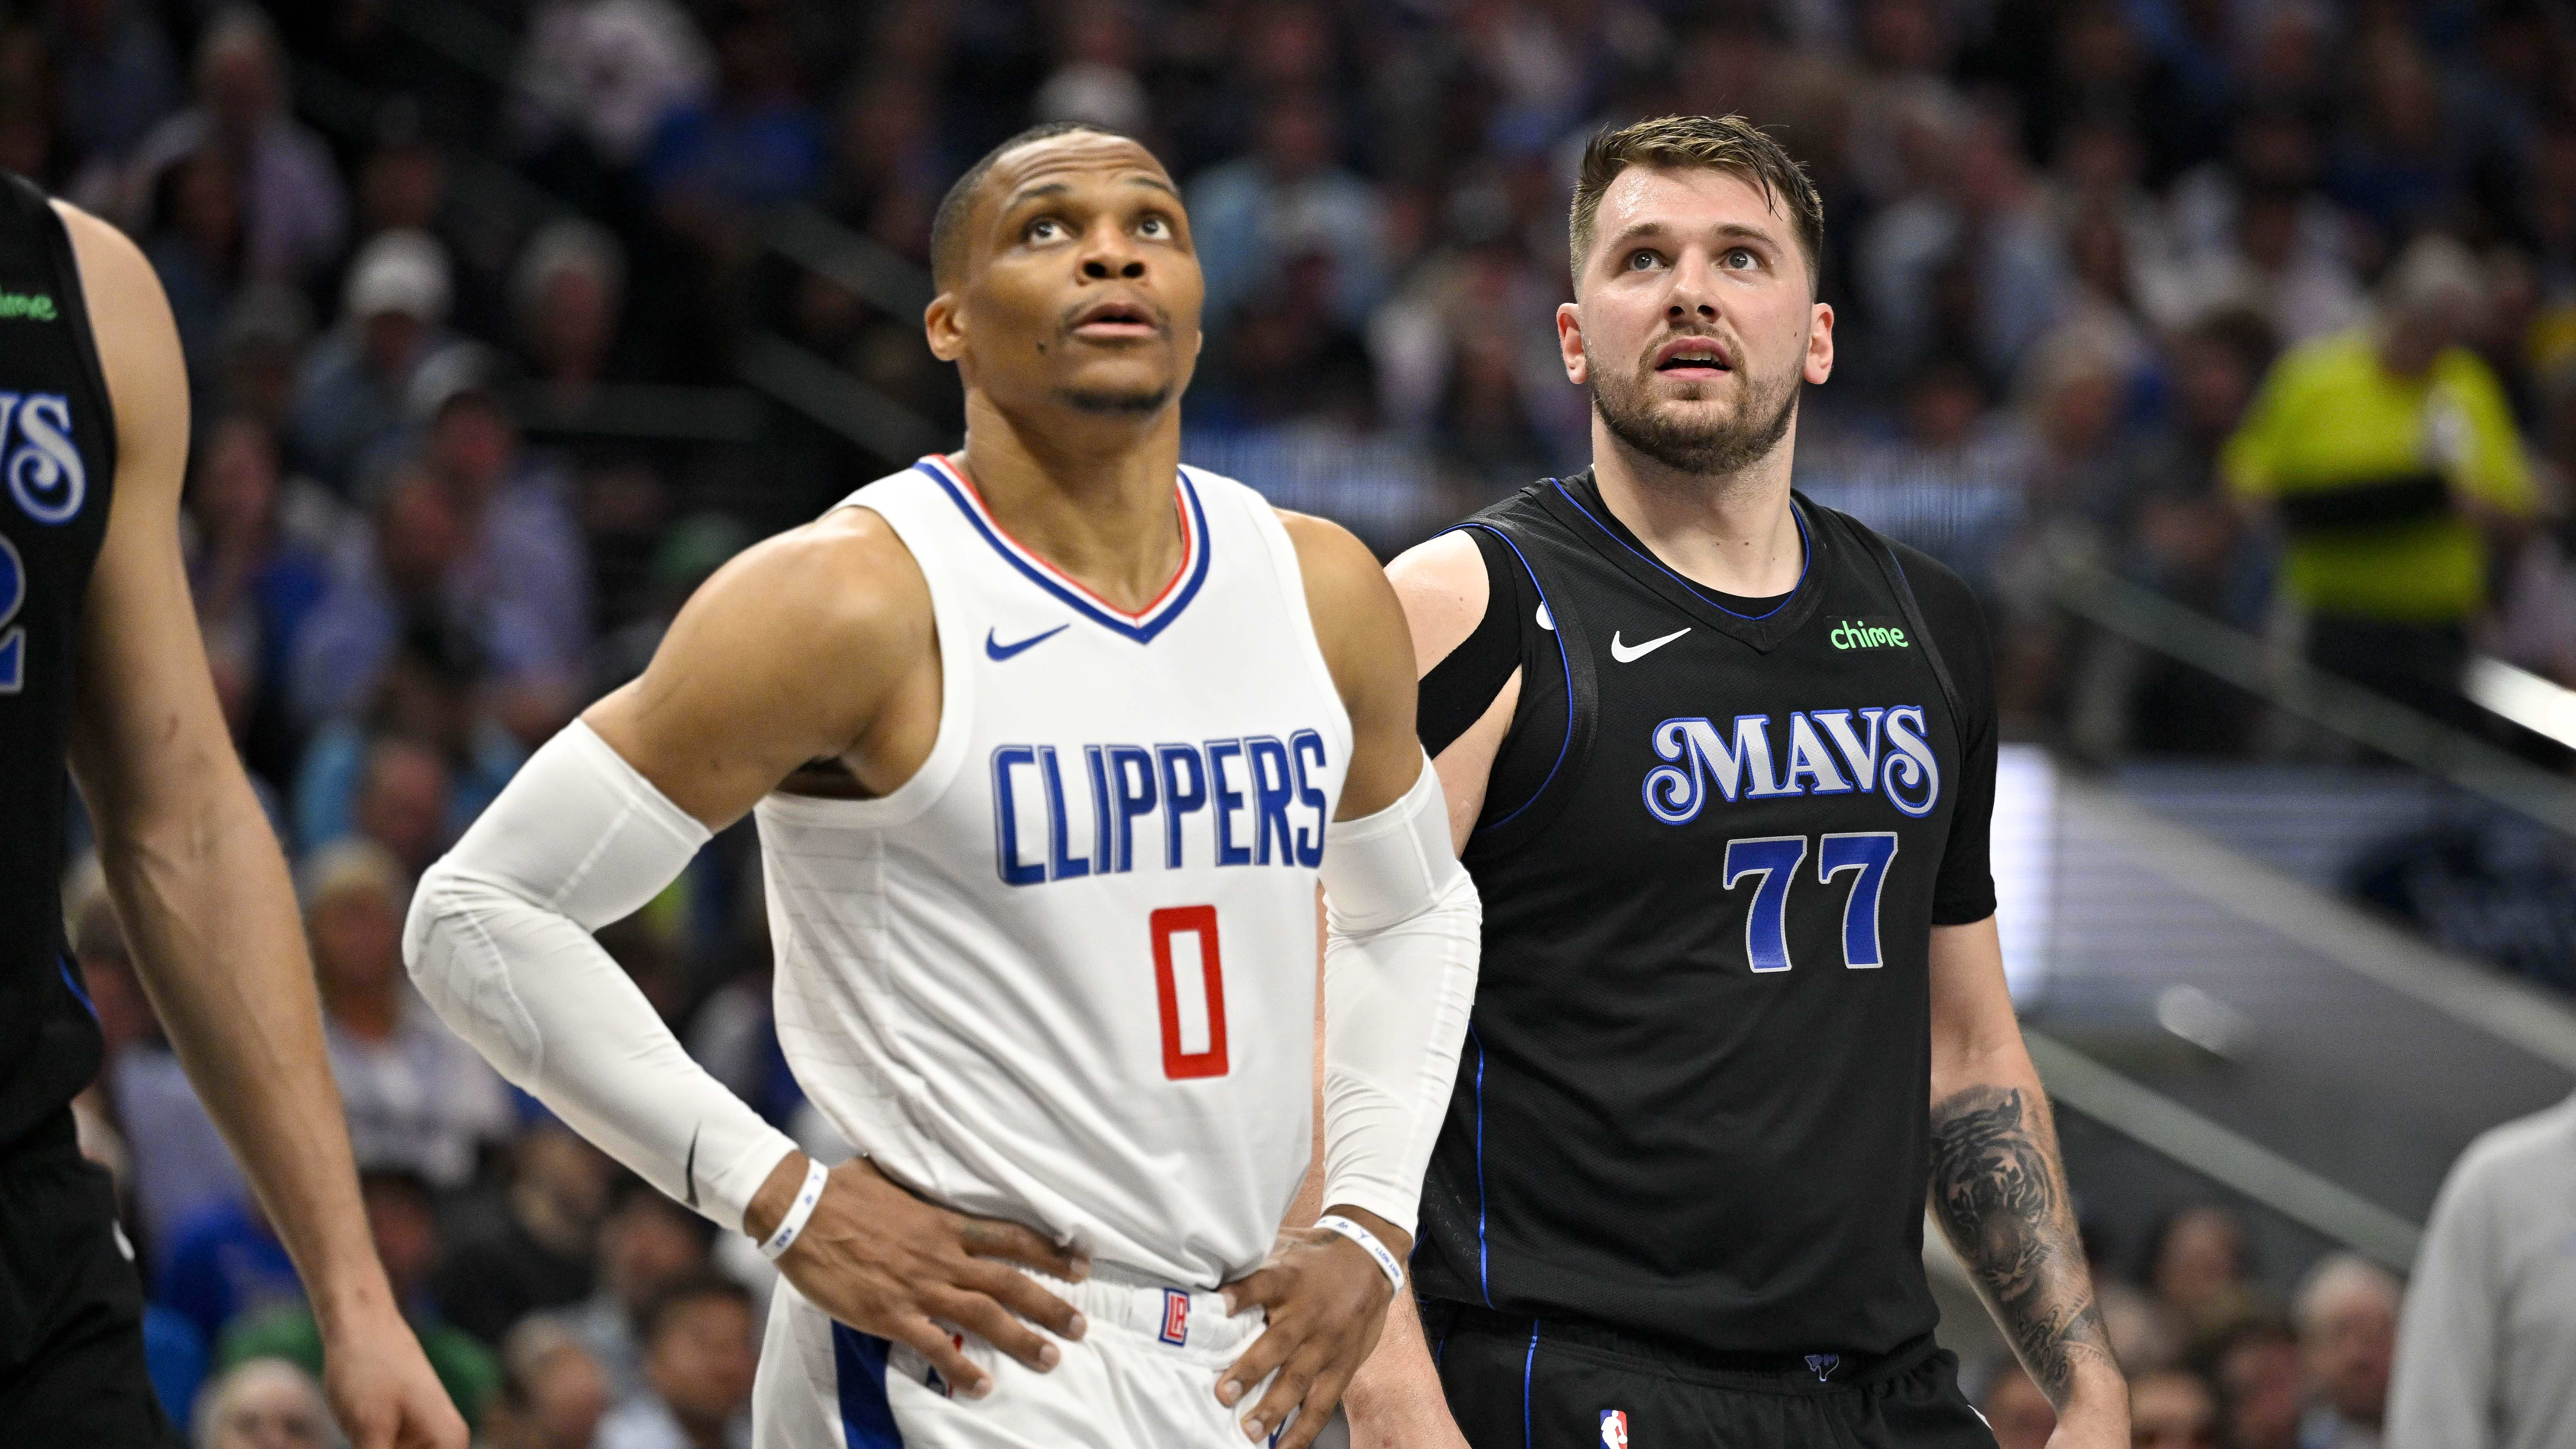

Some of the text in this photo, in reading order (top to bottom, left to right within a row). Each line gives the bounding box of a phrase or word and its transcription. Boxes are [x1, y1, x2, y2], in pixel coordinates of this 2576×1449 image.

[1831, 620, 1908, 648] chime
[990, 728, 1326, 887] CLIPPERS
[1642, 705, 1939, 826] MAVS
[1723, 832, 1898, 973] 77
[1150, 904, 1229, 1081] 0
